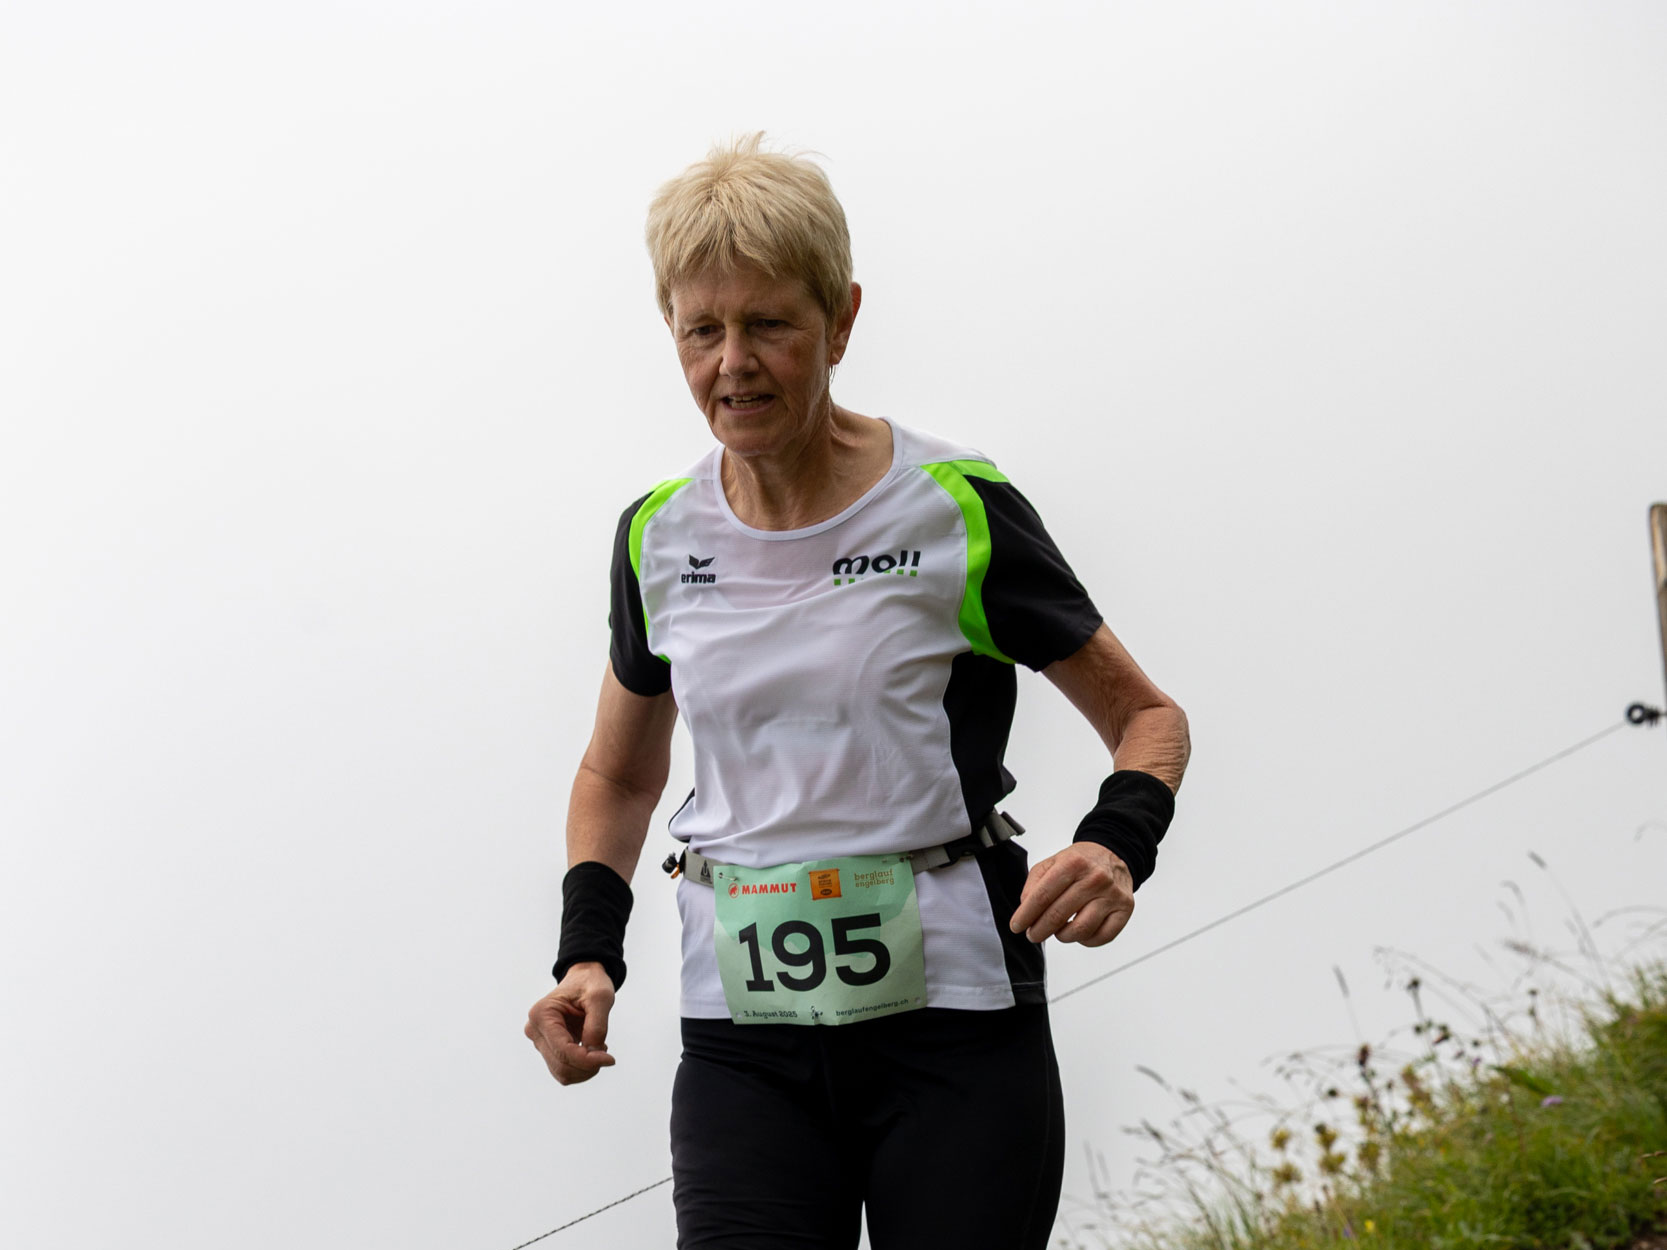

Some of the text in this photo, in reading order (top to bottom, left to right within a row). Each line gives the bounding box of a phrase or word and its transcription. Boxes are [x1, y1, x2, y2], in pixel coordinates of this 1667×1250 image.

[681, 573, 716, 584] erima
[854, 869, 893, 882] berglauf
[741, 883, 797, 895] MAMMUT
[855, 878, 895, 889] engelberg
[738, 912, 891, 992] 195
[836, 998, 909, 1017] berglaufengelberg.ch
[752, 1010, 779, 1019] August
[779, 1010, 798, 1018] 2025
